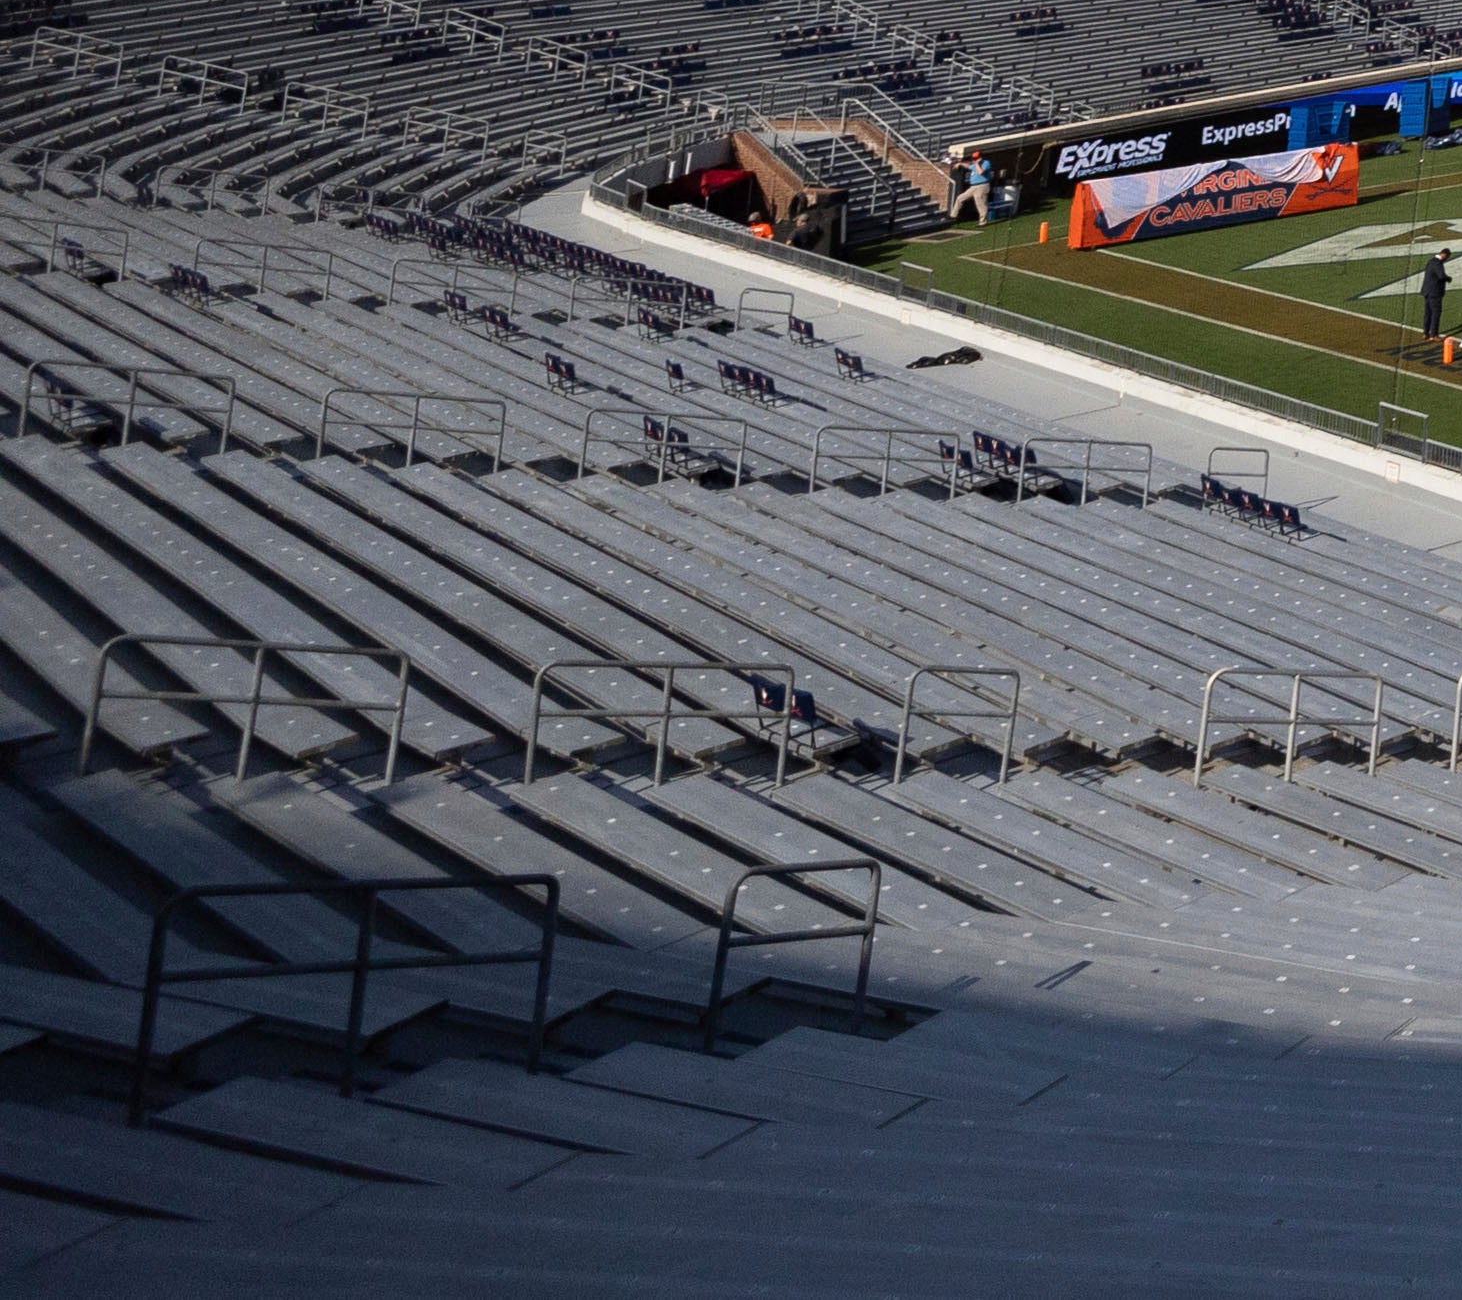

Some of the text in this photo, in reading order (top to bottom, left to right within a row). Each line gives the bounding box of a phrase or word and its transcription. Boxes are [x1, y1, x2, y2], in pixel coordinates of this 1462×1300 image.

[1055, 132, 1169, 179] Express
[1178, 169, 1280, 197] IRGIN
[1150, 188, 1287, 228] CAVALIERS
